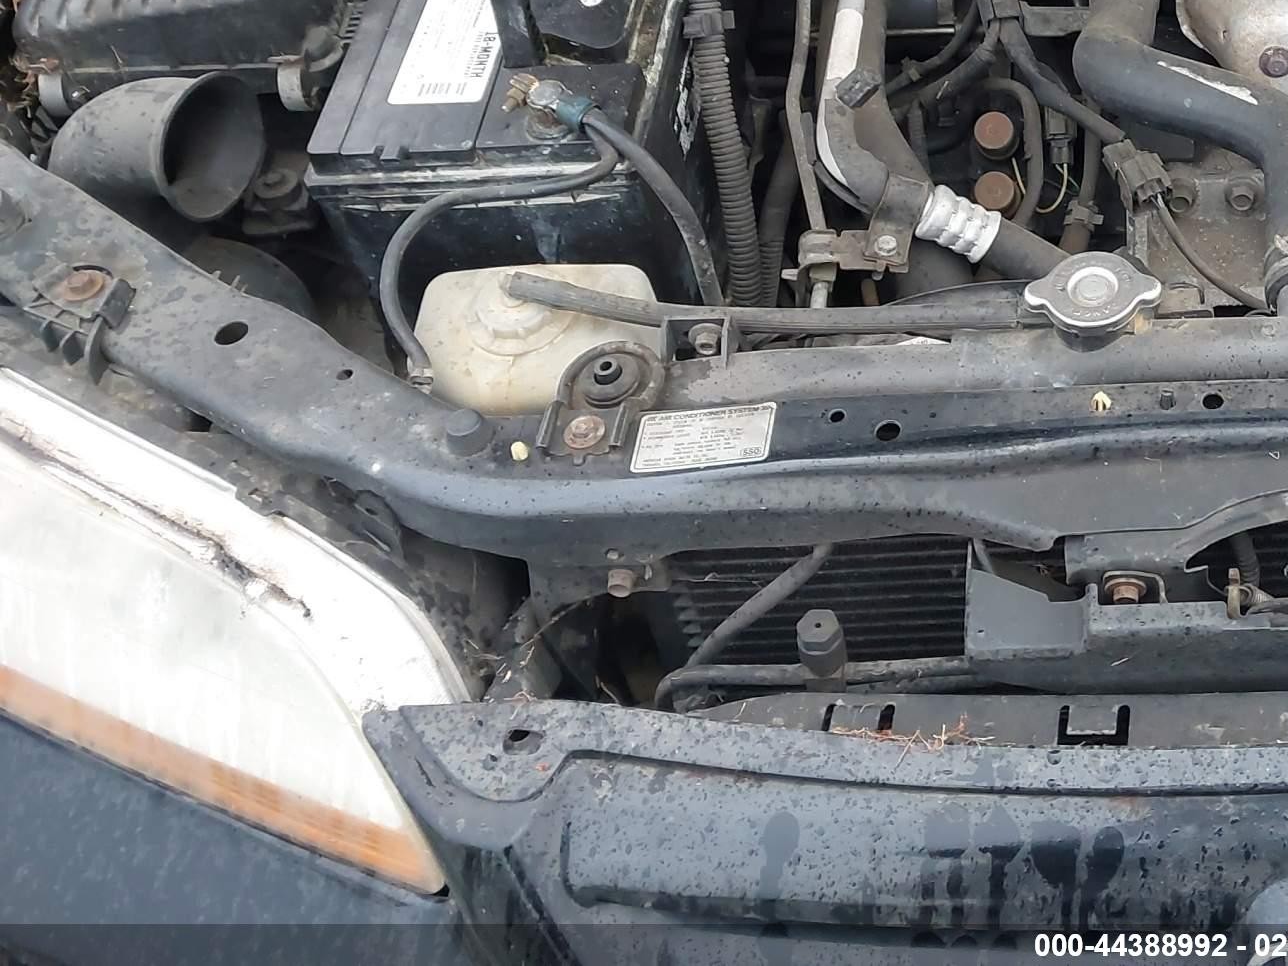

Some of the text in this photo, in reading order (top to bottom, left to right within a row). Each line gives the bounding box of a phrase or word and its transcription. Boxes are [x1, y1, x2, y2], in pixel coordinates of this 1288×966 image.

[470, 32, 499, 77] 18-MONTH
[673, 410, 726, 421] CONDITIONER
[727, 406, 760, 416] SYSTEM
